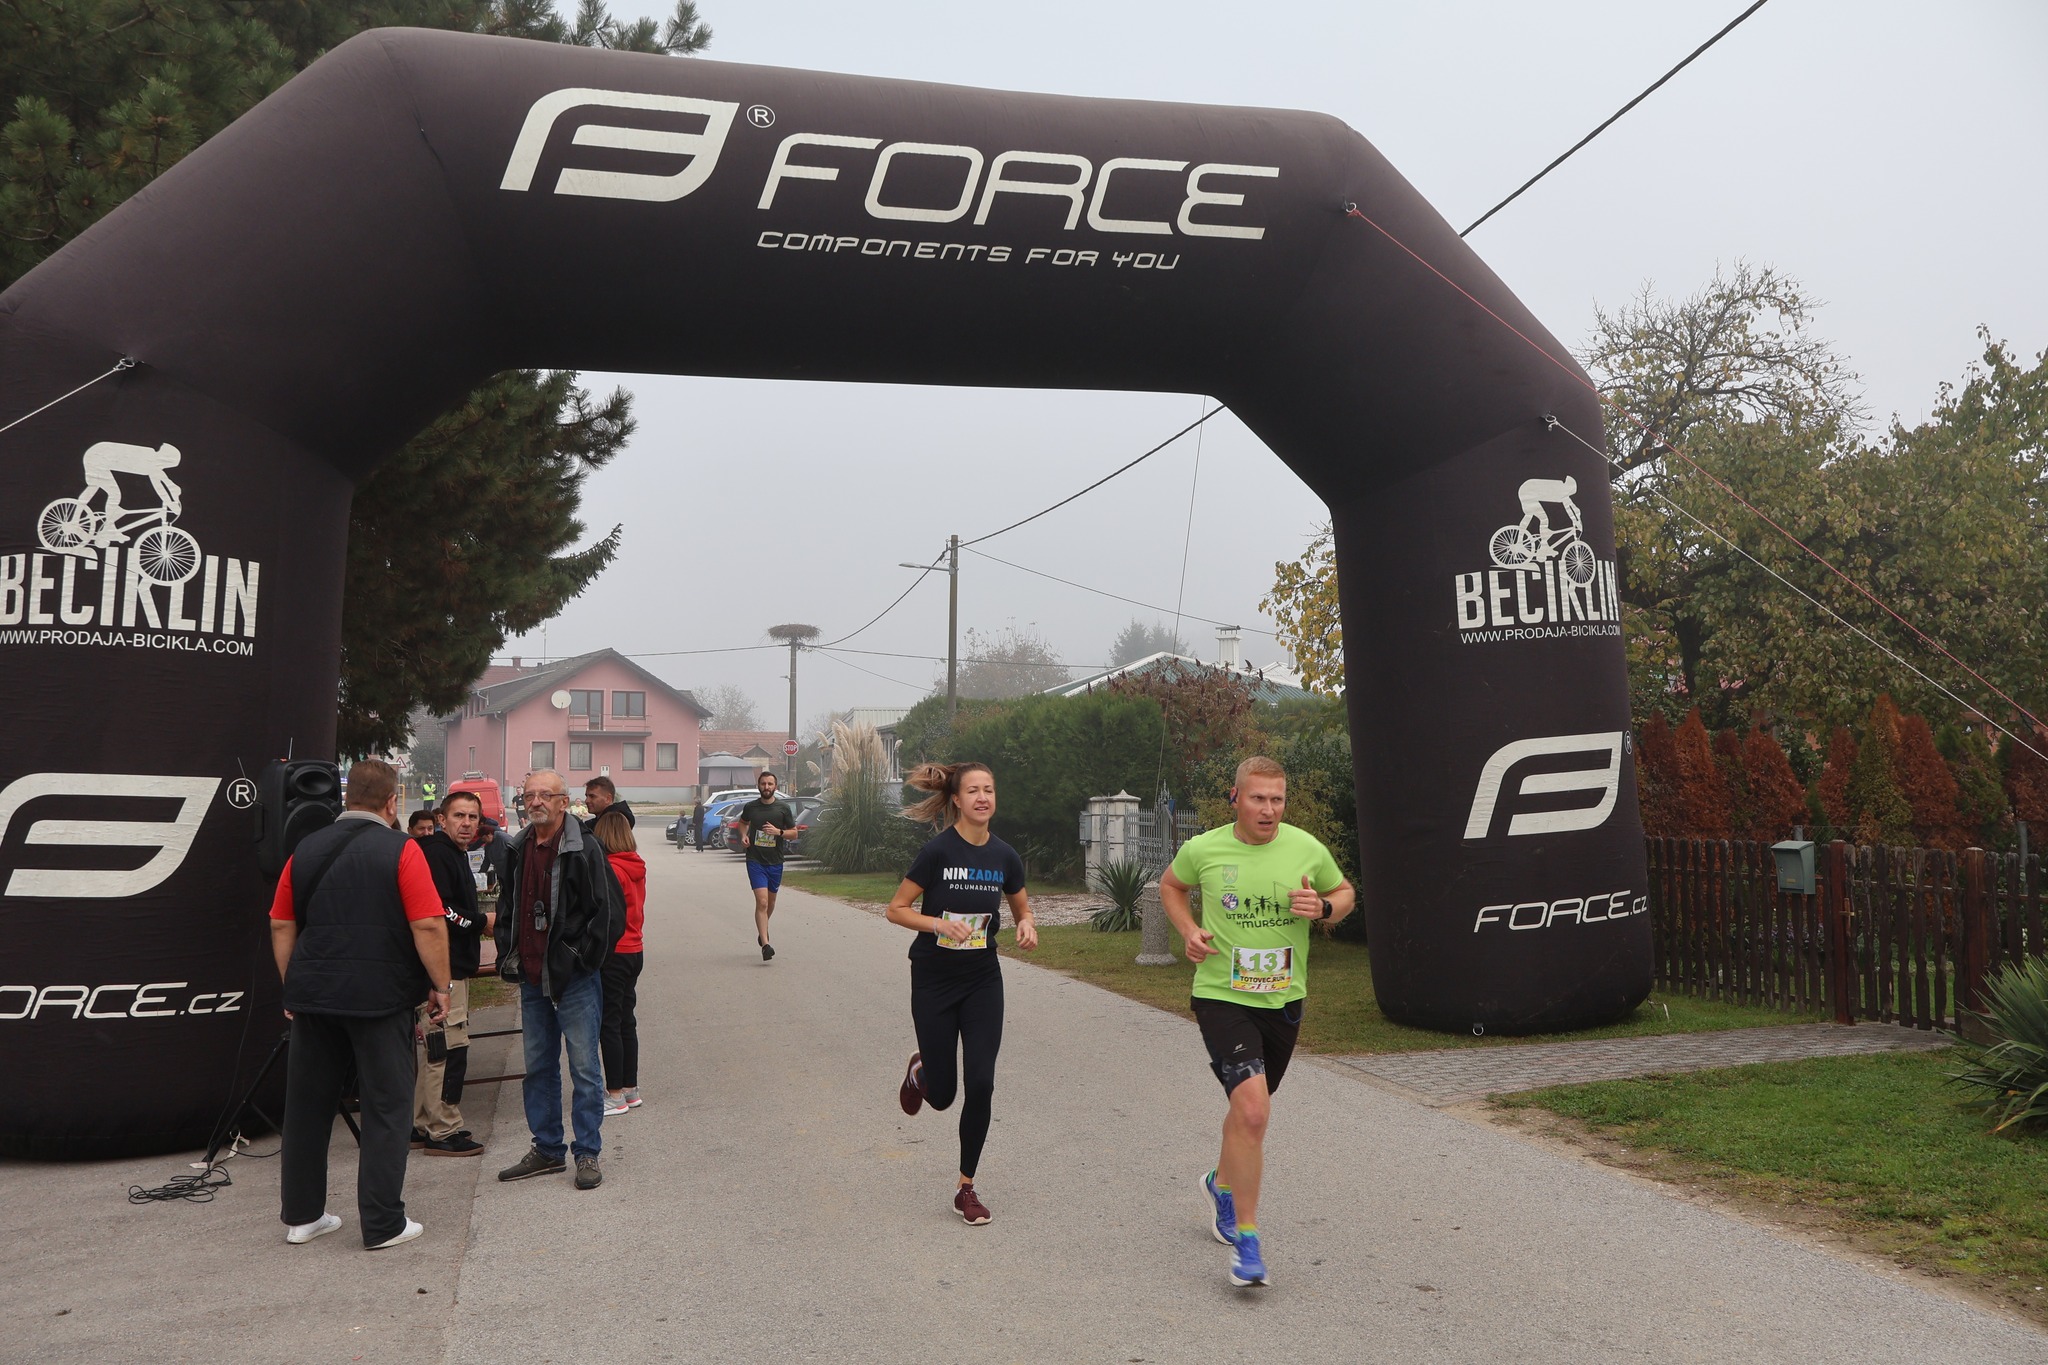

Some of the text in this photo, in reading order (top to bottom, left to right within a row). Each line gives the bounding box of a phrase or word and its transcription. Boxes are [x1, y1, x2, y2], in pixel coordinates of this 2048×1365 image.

[757, 133, 1279, 239] FORCE
[757, 231, 1180, 270] COMPONENTS FOR YOU
[0, 547, 260, 637] BECIKLIN
[1455, 560, 1620, 629] BECIKLIN
[1249, 952, 1278, 972] 13
